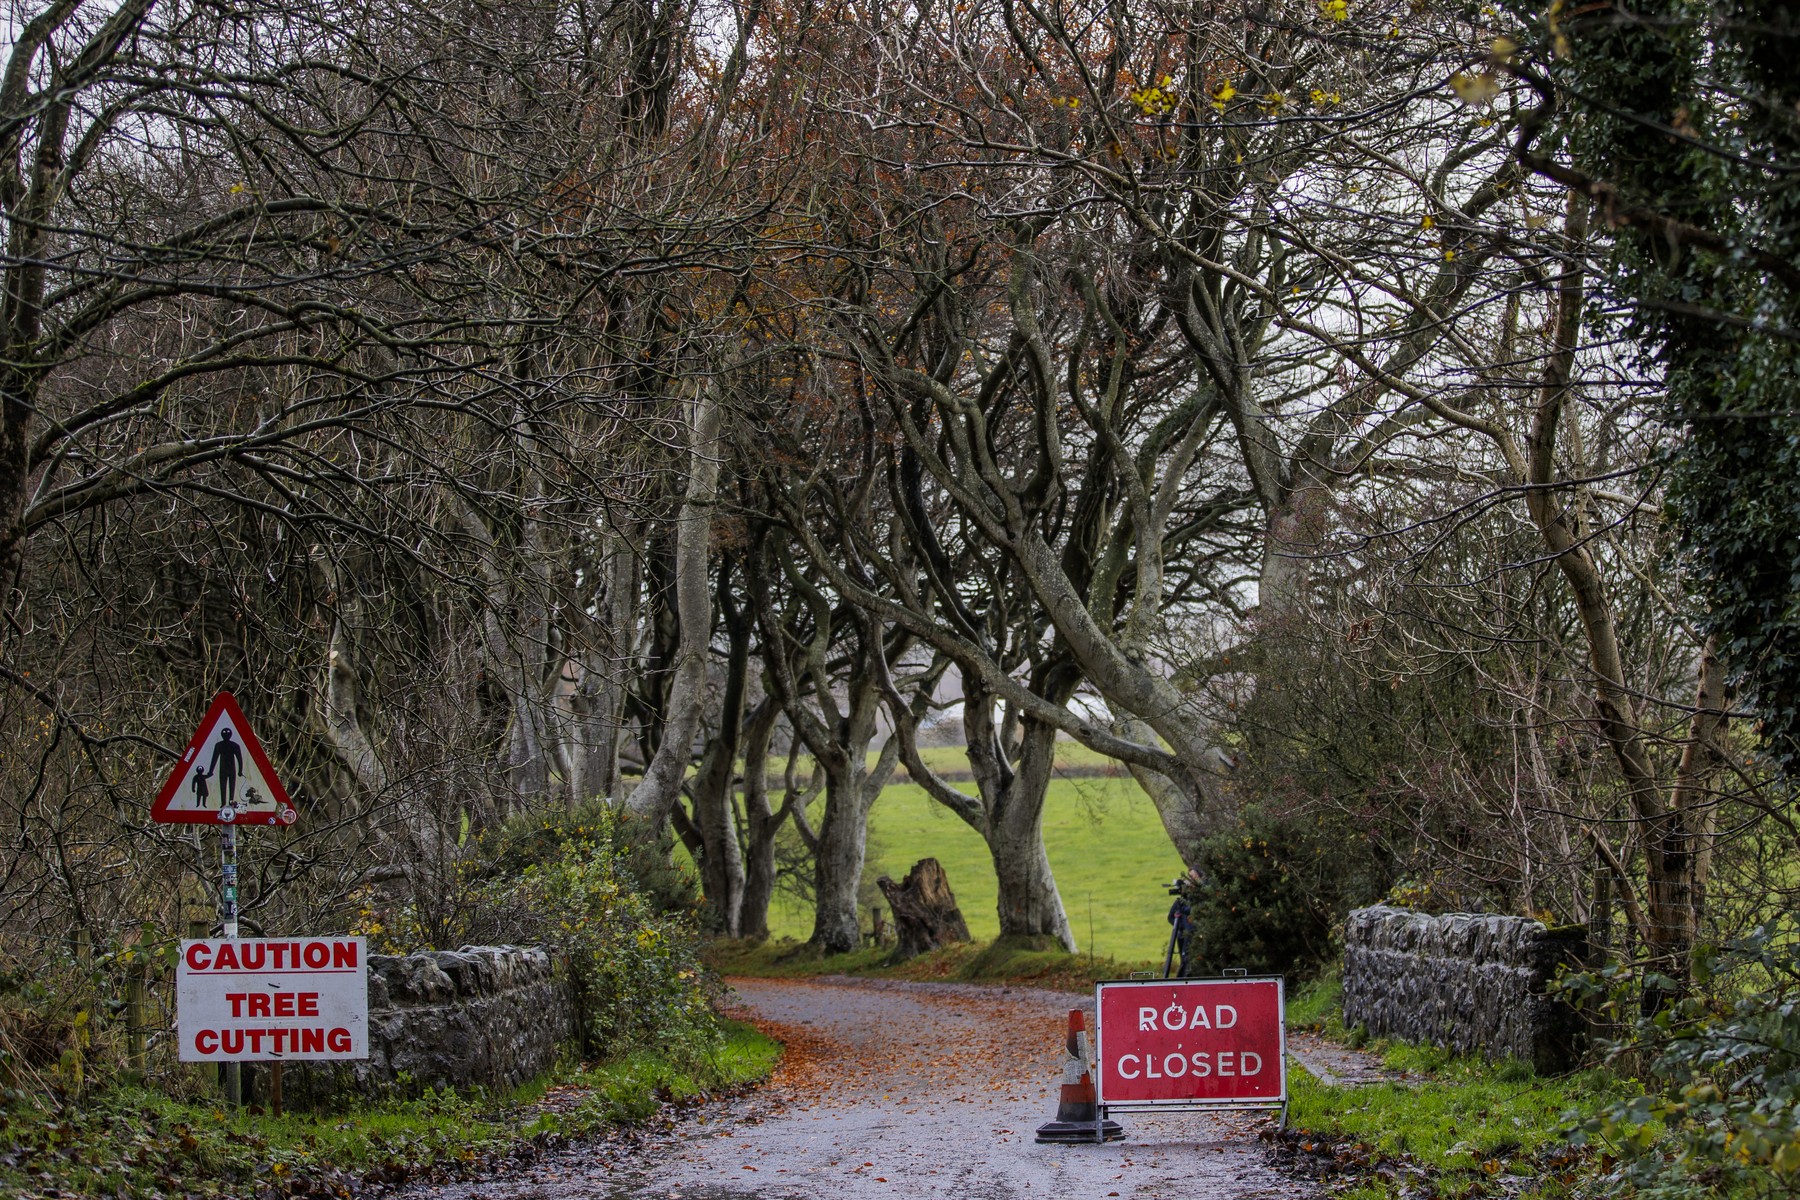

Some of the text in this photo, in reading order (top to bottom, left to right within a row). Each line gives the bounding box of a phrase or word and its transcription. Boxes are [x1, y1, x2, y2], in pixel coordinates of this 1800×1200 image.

[186, 942, 358, 970] CAUTION
[225, 992, 319, 1017] TREE
[1139, 1004, 1238, 1031] ROAD
[195, 1028, 352, 1054] CUTTING
[1117, 1051, 1262, 1080] CLOSED
